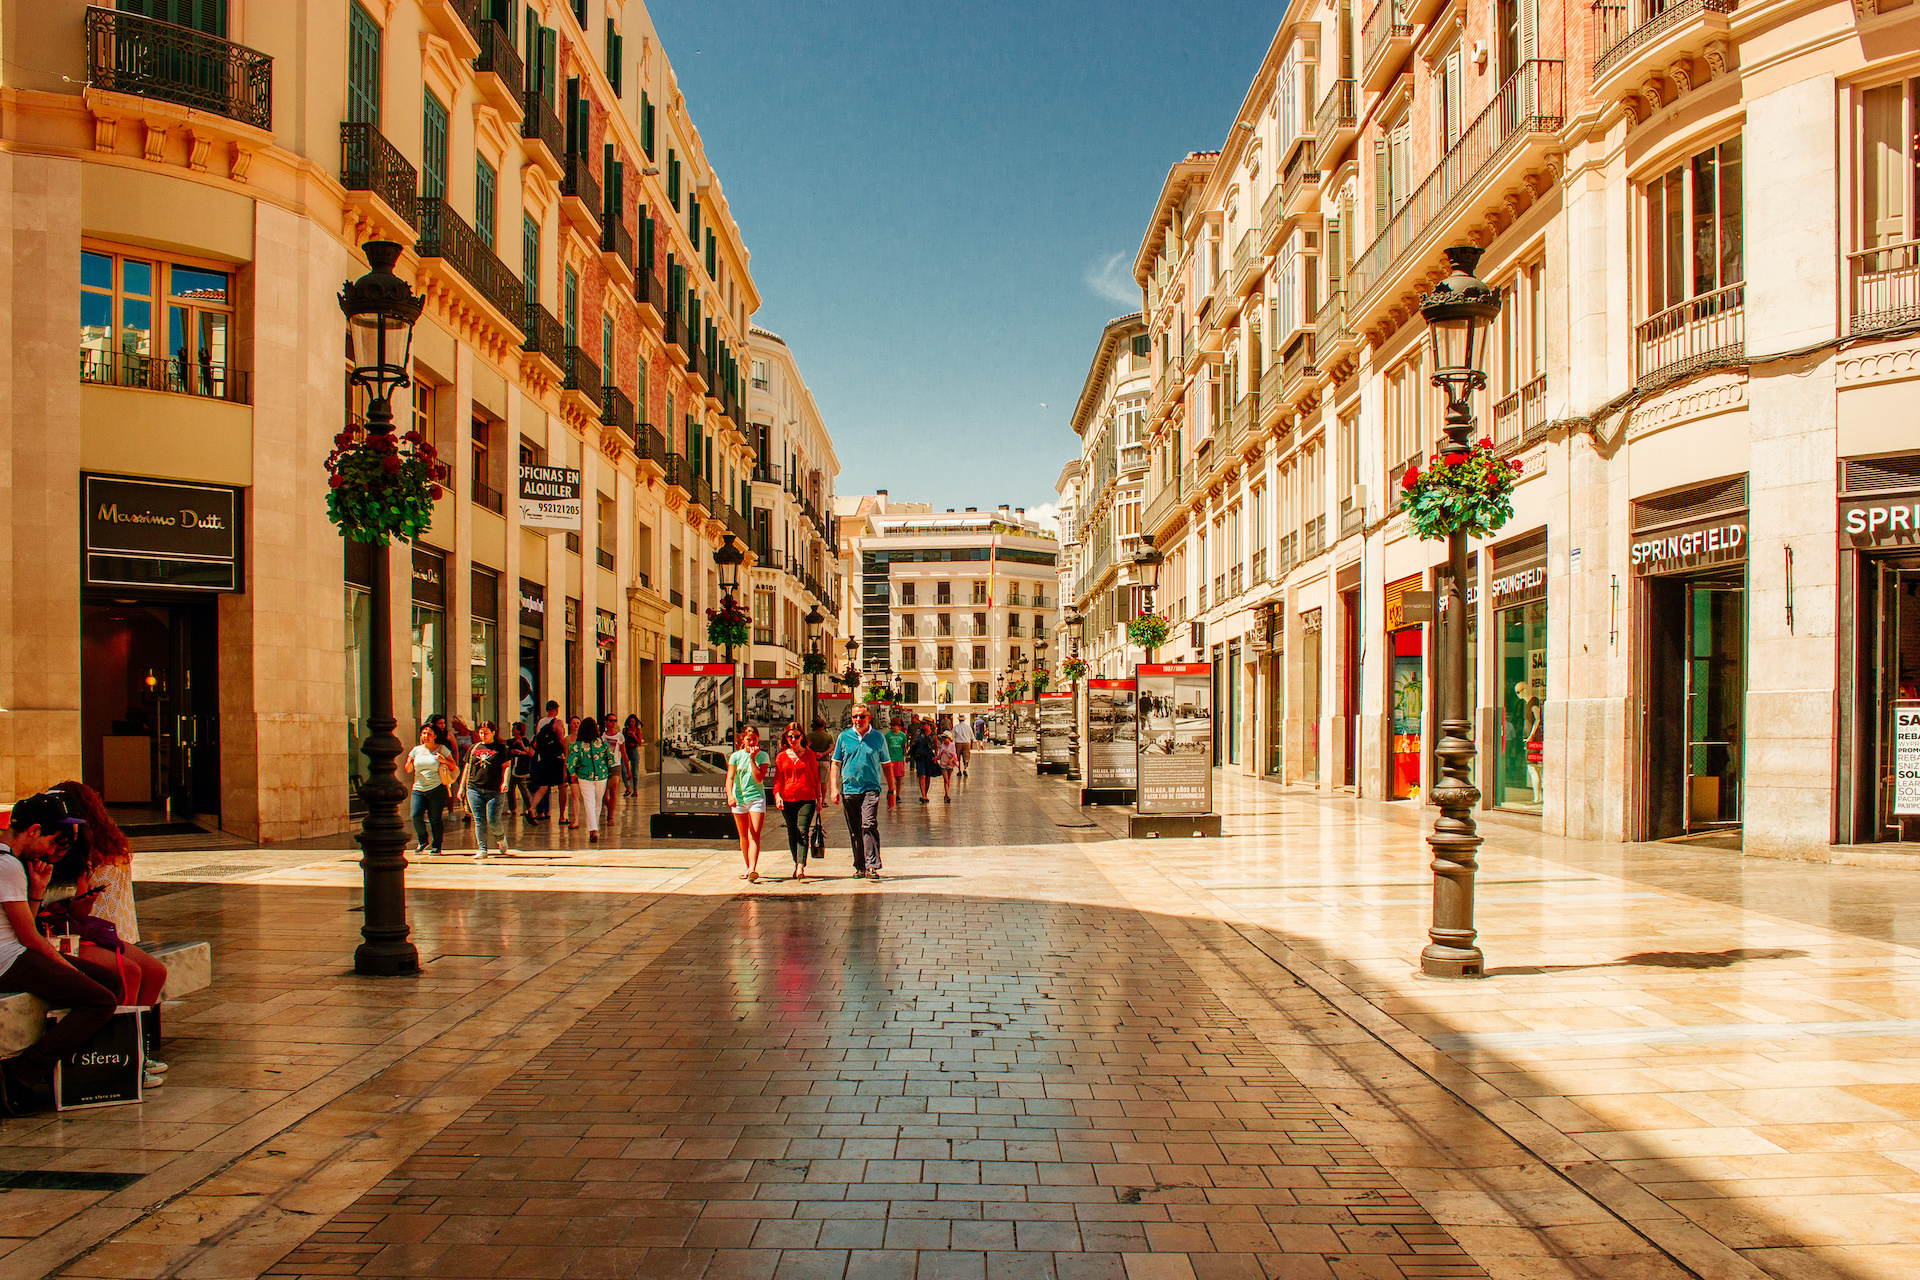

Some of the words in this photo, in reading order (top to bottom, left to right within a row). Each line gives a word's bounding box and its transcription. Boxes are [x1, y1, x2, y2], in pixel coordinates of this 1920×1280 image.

[519, 466, 564, 483] OFICINAS
[566, 471, 579, 485] EN
[524, 481, 572, 498] ALQUILER
[98, 503, 176, 526] Massimo
[179, 509, 226, 530] Dutti
[538, 502, 580, 515] 952121205
[1631, 524, 1744, 565] SPRINGFIELD
[1492, 567, 1543, 597] SPRINGFIELD
